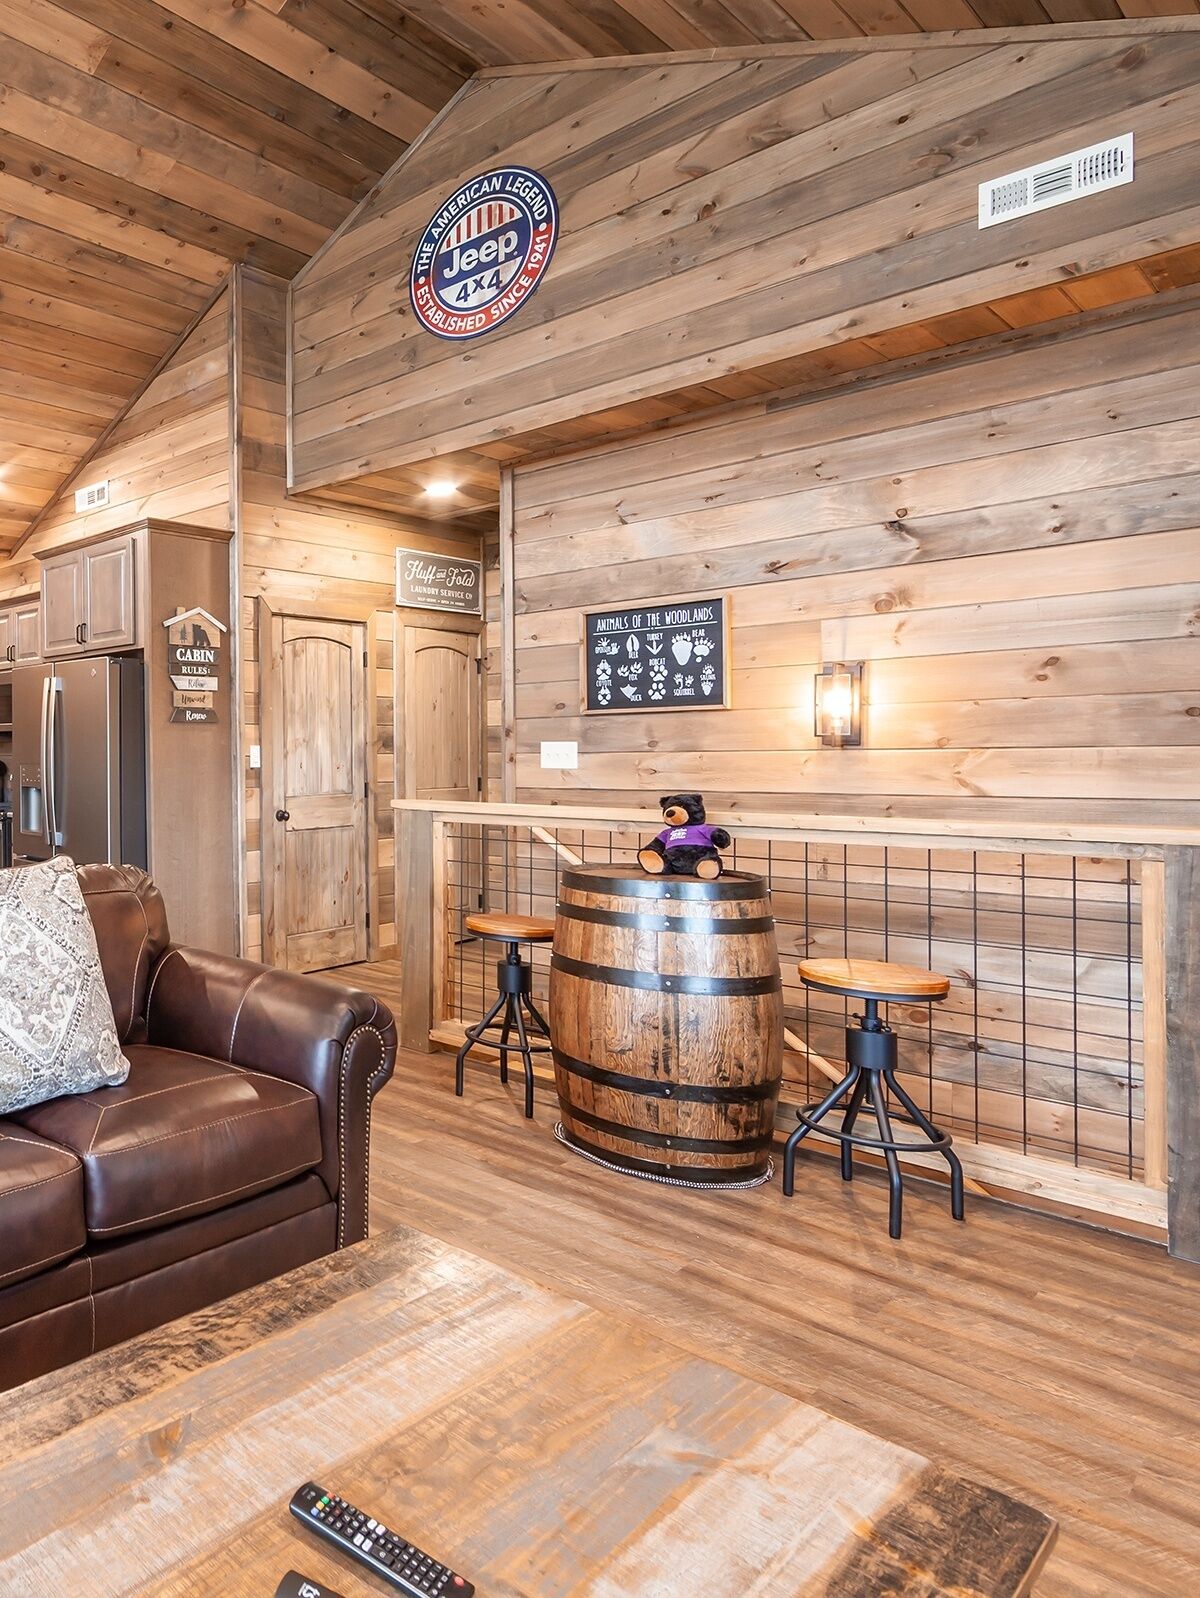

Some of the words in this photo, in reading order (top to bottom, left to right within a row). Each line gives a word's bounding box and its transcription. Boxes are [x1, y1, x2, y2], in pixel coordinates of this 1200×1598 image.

[417, 242, 435, 273] THE
[432, 175, 503, 239] AMERICAN
[505, 175, 549, 221] LEGEND
[443, 230, 519, 279] Jeep
[416, 285, 486, 331] ESTABLISHED
[491, 274, 532, 321] SINCE
[527, 234, 549, 271] 1941
[446, 567, 475, 587] Fold
[410, 585, 439, 596] LAUNDRY
[440, 589, 464, 598] SERVICE
[596, 615, 629, 632] ANIMALS
[632, 614, 643, 628] OF
[646, 612, 660, 627] THE
[665, 606, 714, 625] WOODLANDS
[176, 648, 215, 663] CABIN
